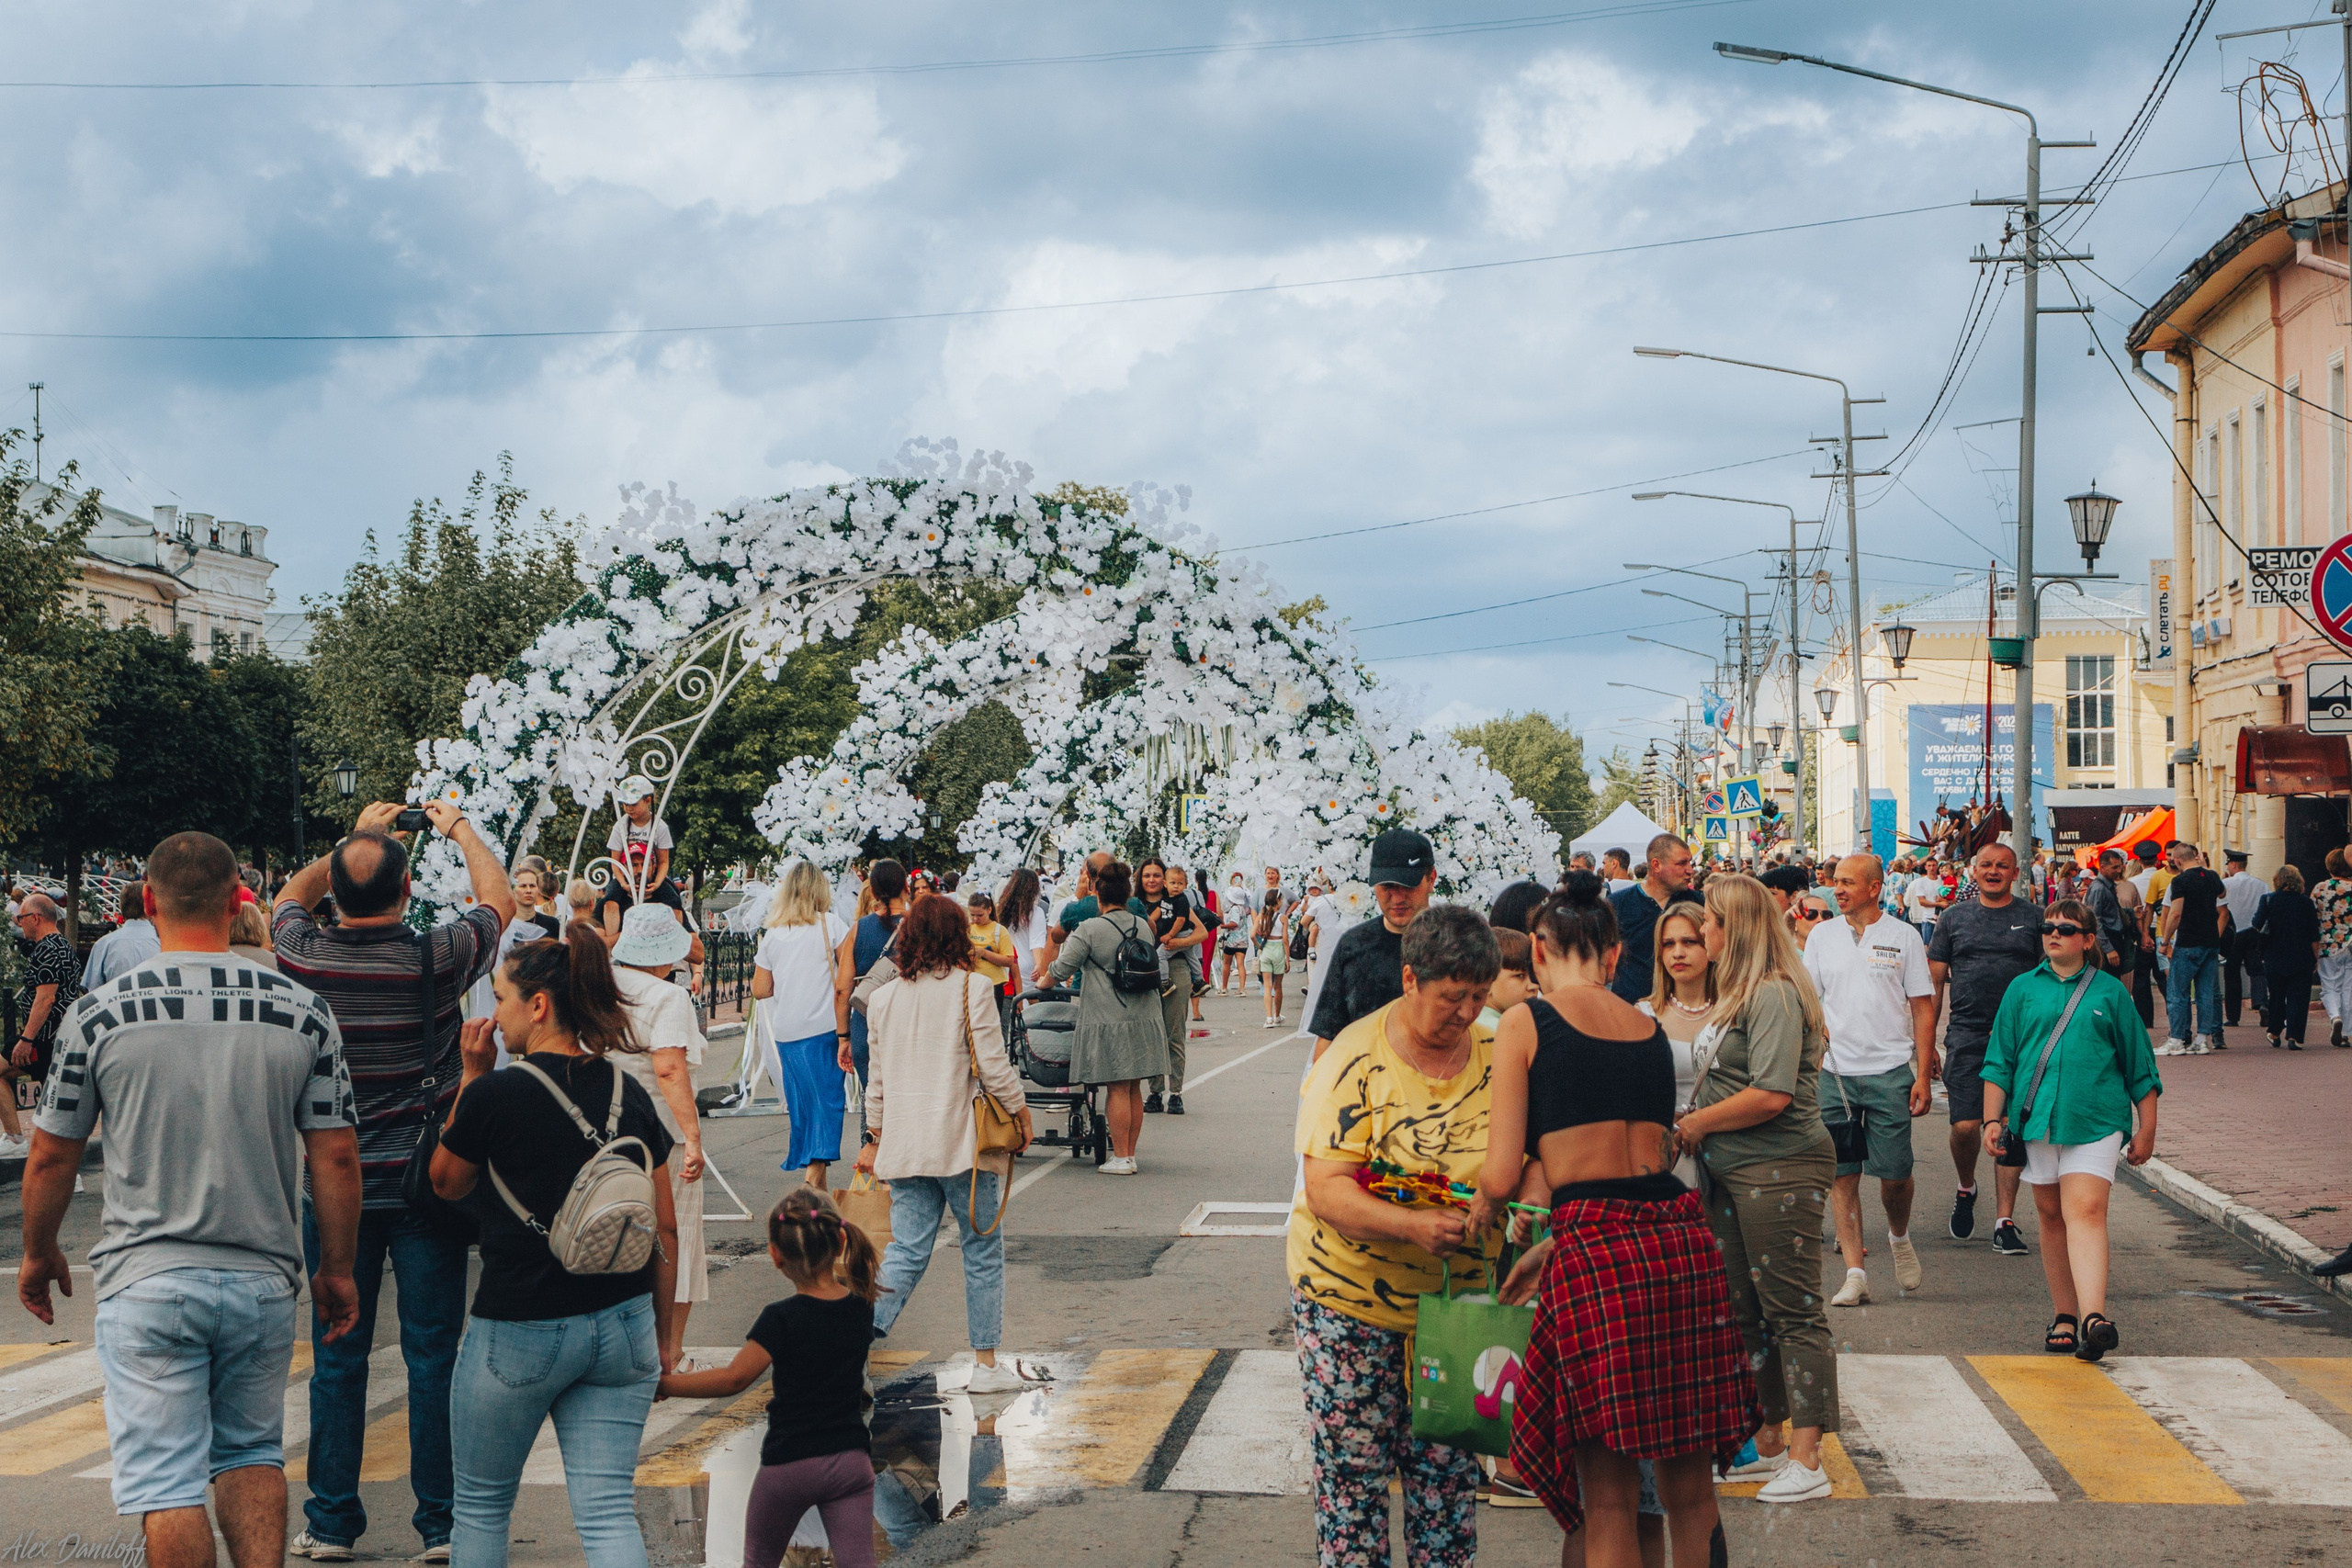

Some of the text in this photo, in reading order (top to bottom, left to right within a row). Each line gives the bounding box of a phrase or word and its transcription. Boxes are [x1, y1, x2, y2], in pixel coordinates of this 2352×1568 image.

[2251, 551, 2319, 569] РЕМО
[2252, 572, 2311, 588] СОТОВ
[1998, 716, 2016, 728] 202
[1925, 754, 1933, 762] И
[1938, 754, 1983, 762] ЖИТЕЛИ
[1921, 768, 1971, 776] СЕРДЕЧНО
[1933, 777, 1952, 785] ВАС
[1955, 777, 1962, 785] С
[1933, 786, 1966, 795] ЛЮБВИ
[76, 1005, 101, 1024] LIONS
[107, 990, 153, 1004] ATHLETIC
[265, 993, 292, 1004] LIONS
[296, 1002, 331, 1027] ATHLETIC
